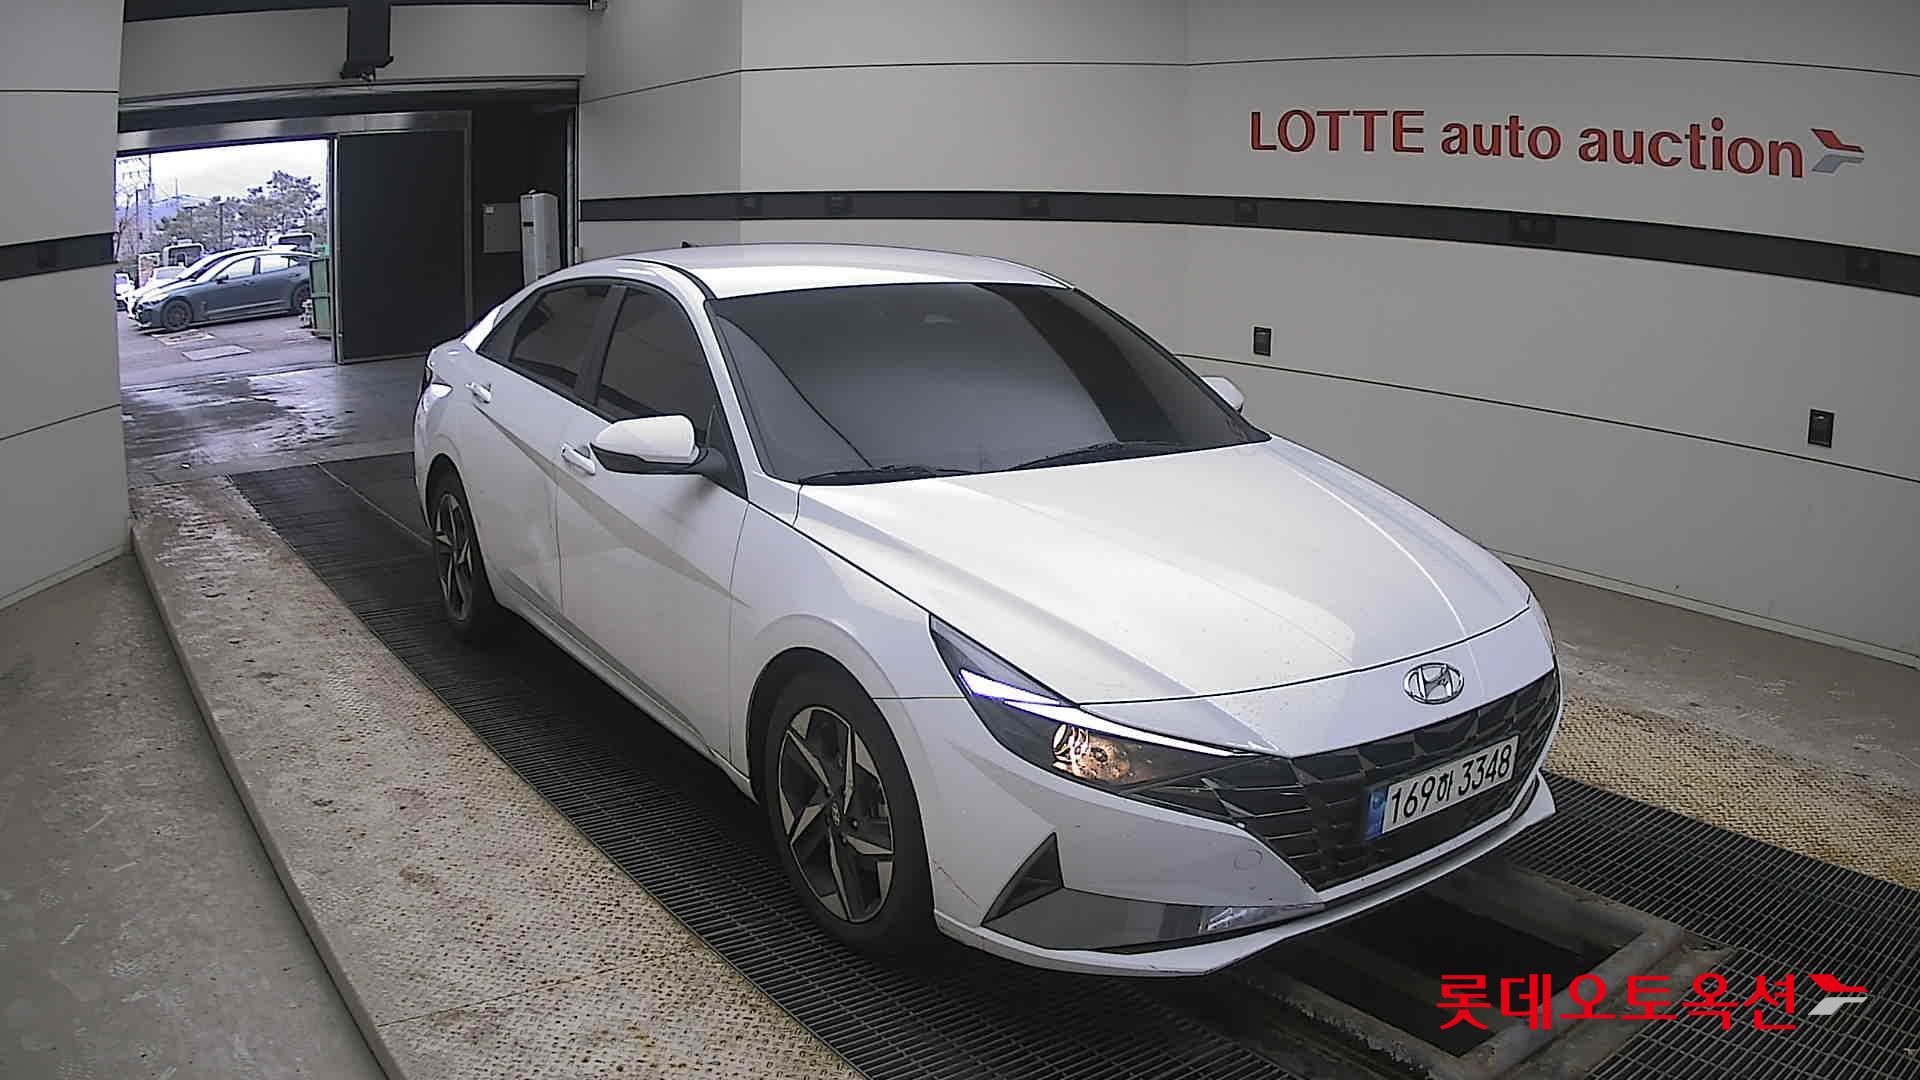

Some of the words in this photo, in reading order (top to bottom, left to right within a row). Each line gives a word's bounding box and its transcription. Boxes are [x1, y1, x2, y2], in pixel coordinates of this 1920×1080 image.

[1250, 109, 1425, 153] LOTTE
[1440, 115, 1562, 160] auto
[1577, 117, 1804, 178] auction
[1391, 770, 1454, 823] 169하
[1458, 744, 1513, 796] 3348
